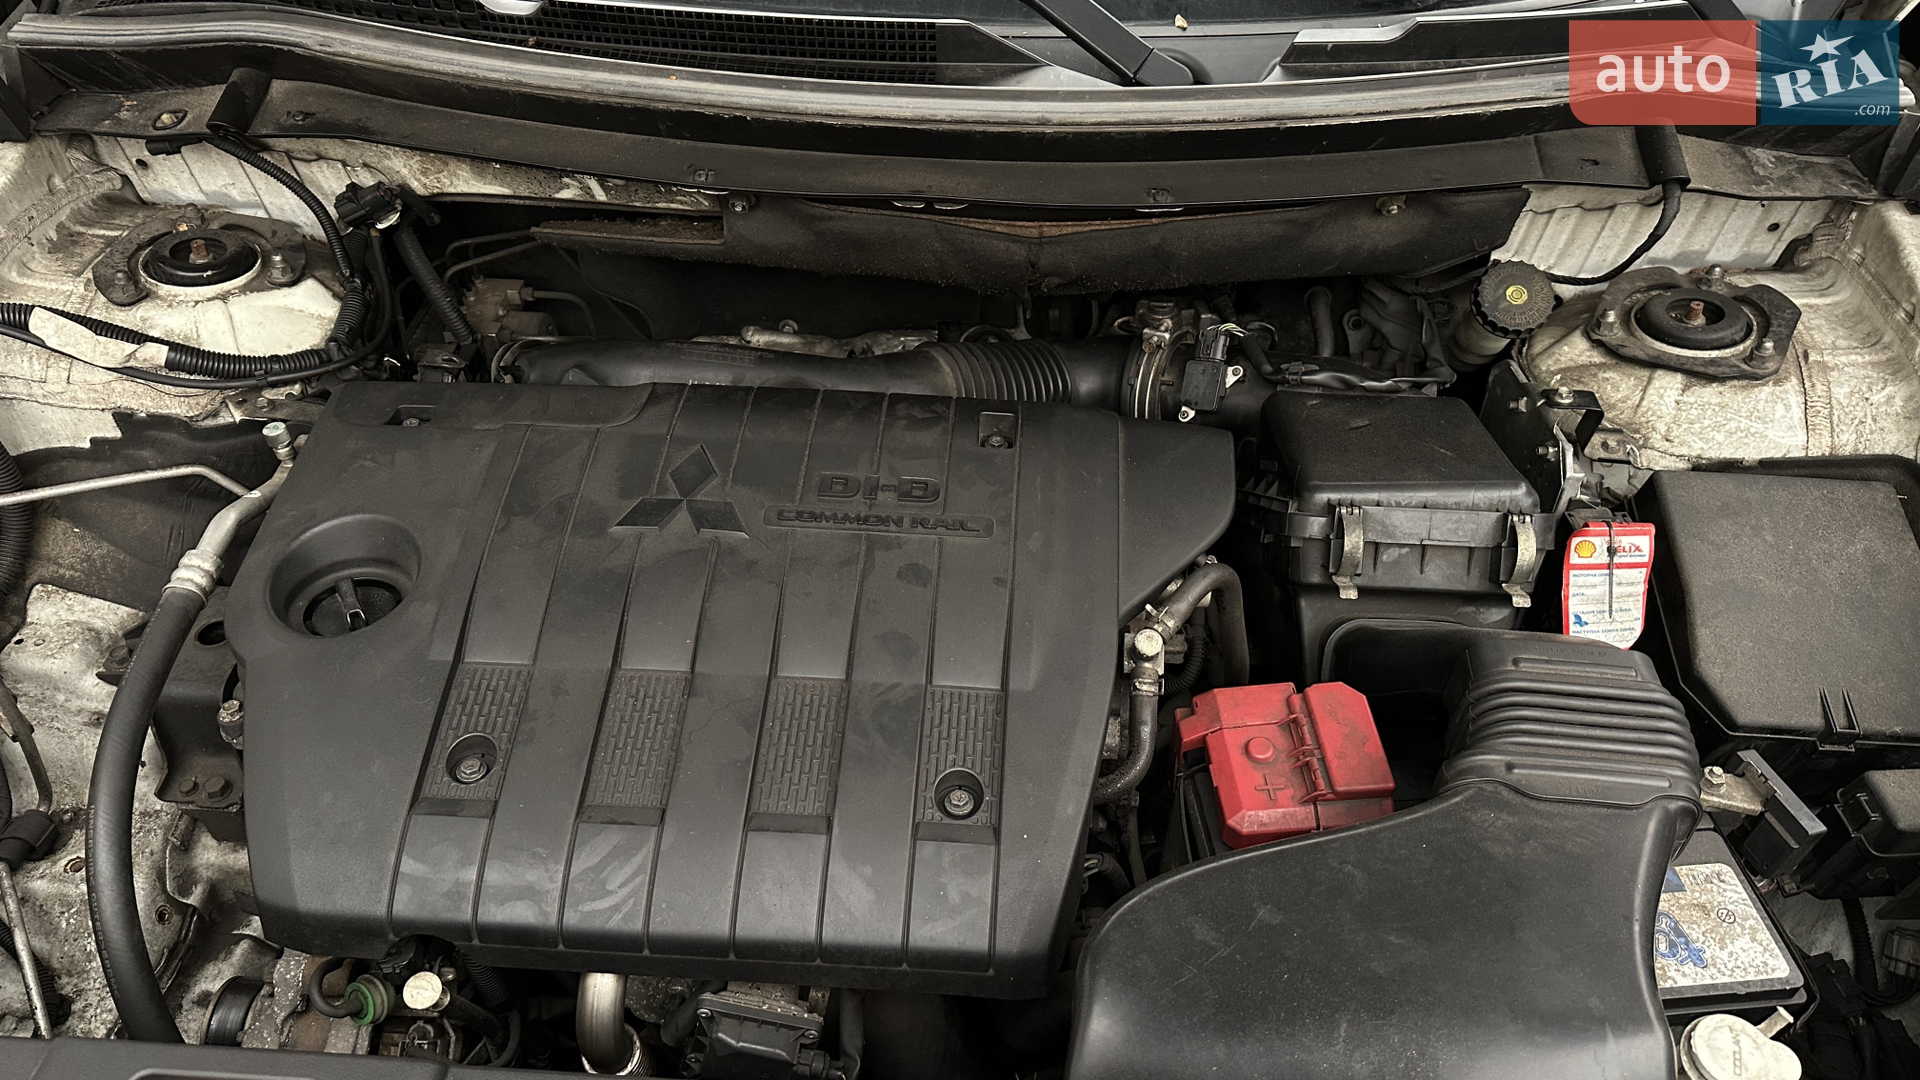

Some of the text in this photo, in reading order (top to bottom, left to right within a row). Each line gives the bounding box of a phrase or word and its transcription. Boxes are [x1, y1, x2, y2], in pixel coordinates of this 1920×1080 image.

[817, 471, 941, 504] DI-D
[776, 508, 981, 533] COMMON RAIL
[1610, 545, 1643, 553] ELIX
